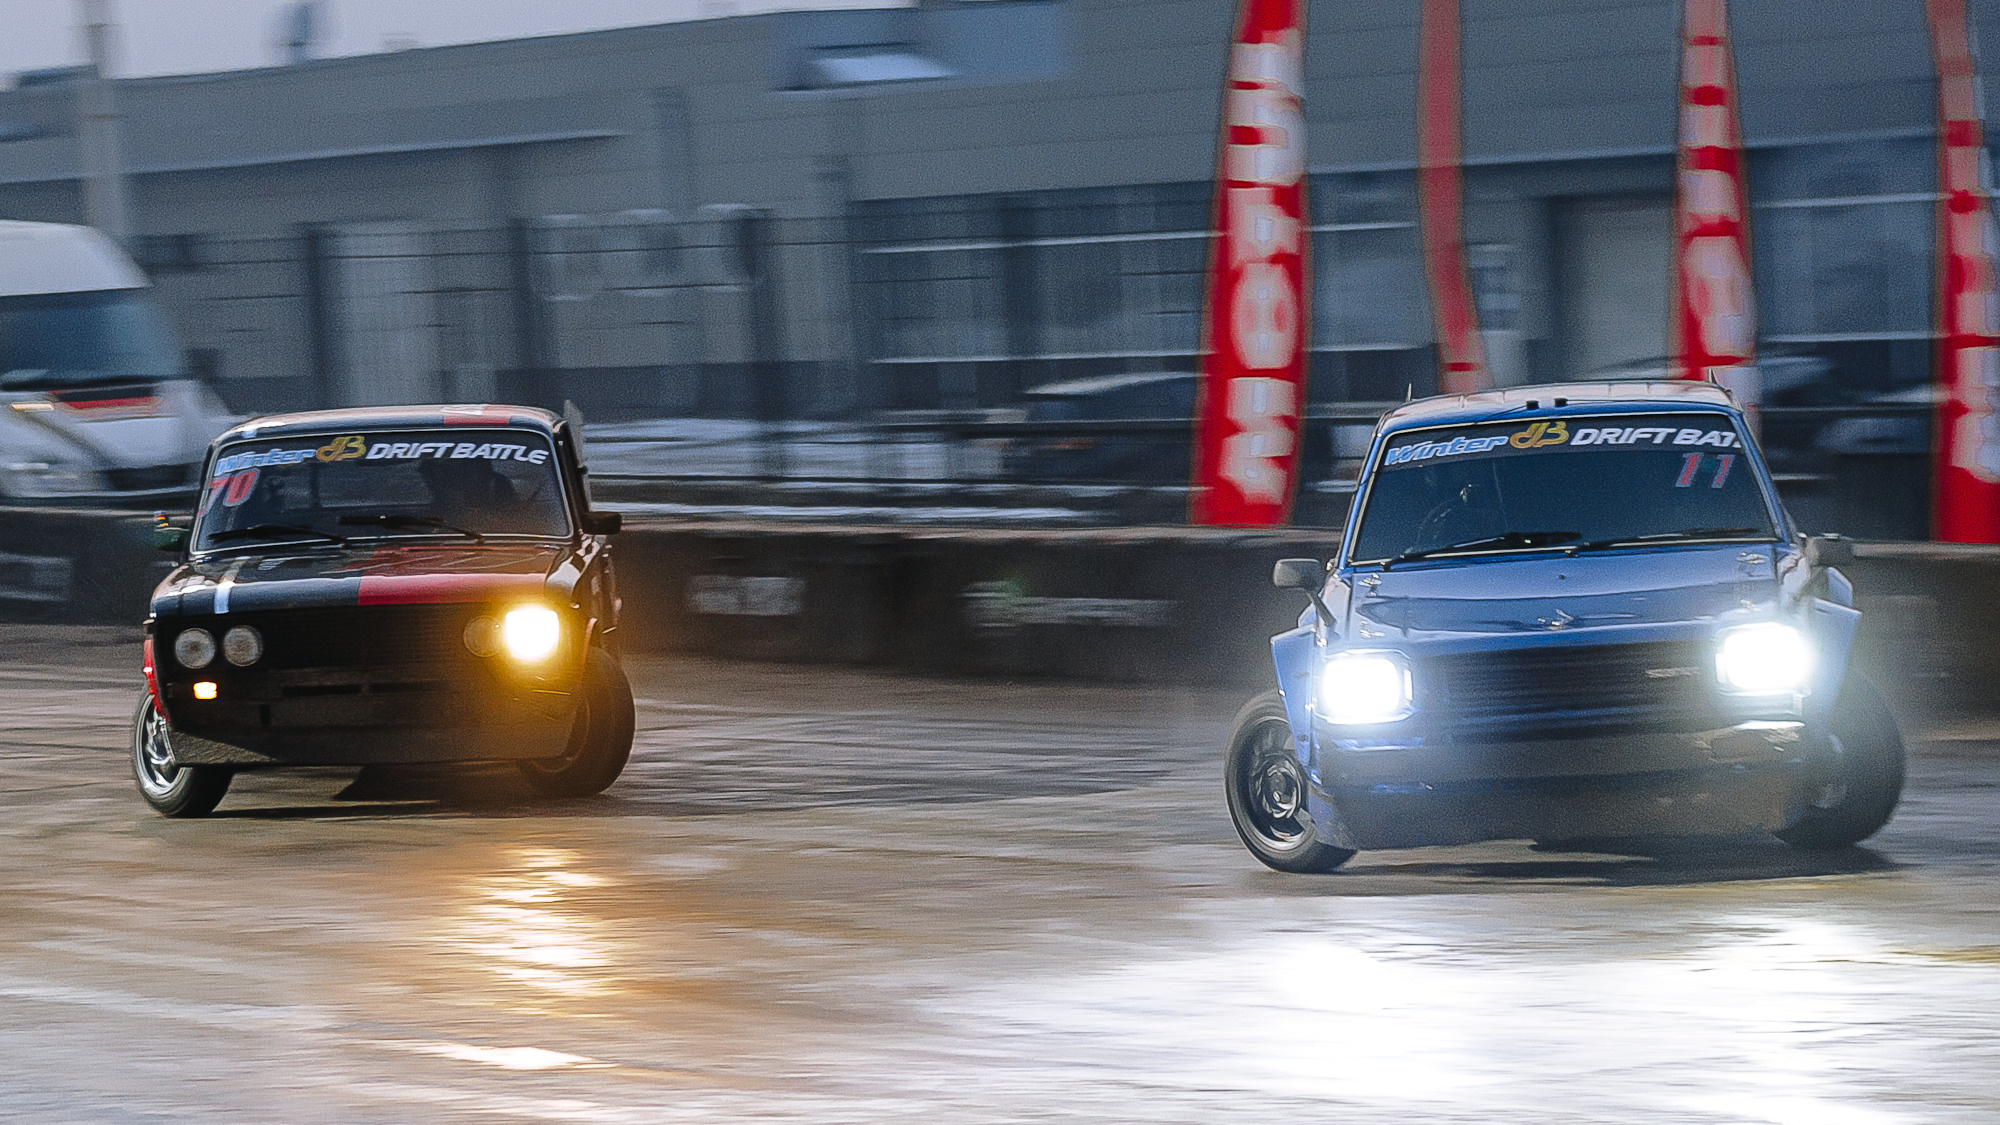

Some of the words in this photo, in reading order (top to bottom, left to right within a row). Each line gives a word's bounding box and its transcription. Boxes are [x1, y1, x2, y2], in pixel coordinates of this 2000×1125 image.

[365, 442, 456, 460] DRIFT
[449, 442, 550, 465] BATTLE
[1384, 436, 1509, 465] Winter
[1570, 427, 1678, 446] DRIFT
[1675, 452, 1736, 489] 11
[197, 467, 261, 518] 70
